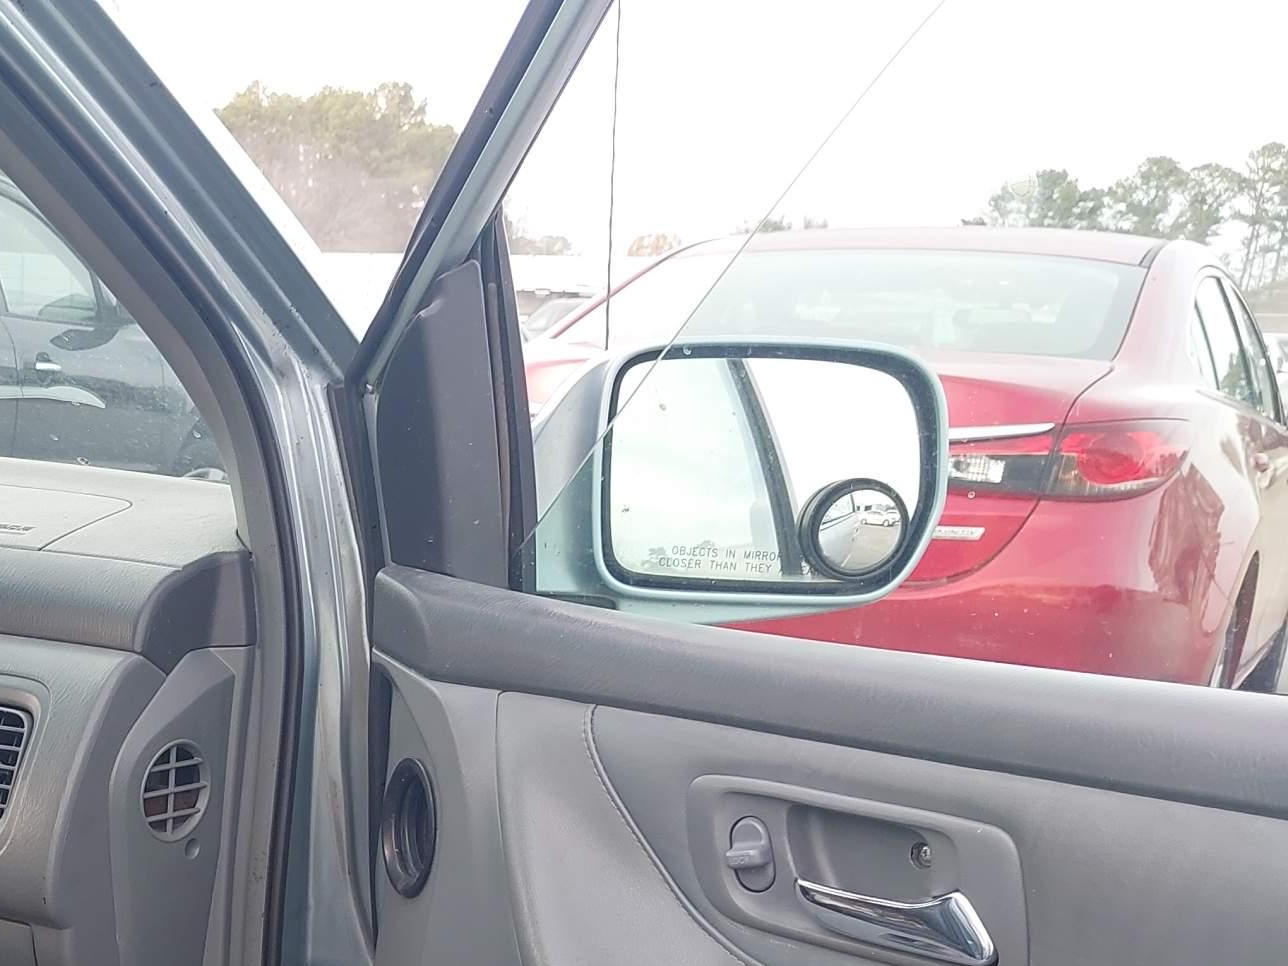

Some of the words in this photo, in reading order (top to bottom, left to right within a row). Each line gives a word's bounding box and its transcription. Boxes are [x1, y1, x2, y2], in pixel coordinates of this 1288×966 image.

[671, 545, 719, 558] OBJECTS
[725, 549, 736, 559] IN
[658, 557, 702, 569] CLOSER
[710, 560, 737, 572] THAN
[745, 562, 772, 574] THEY
